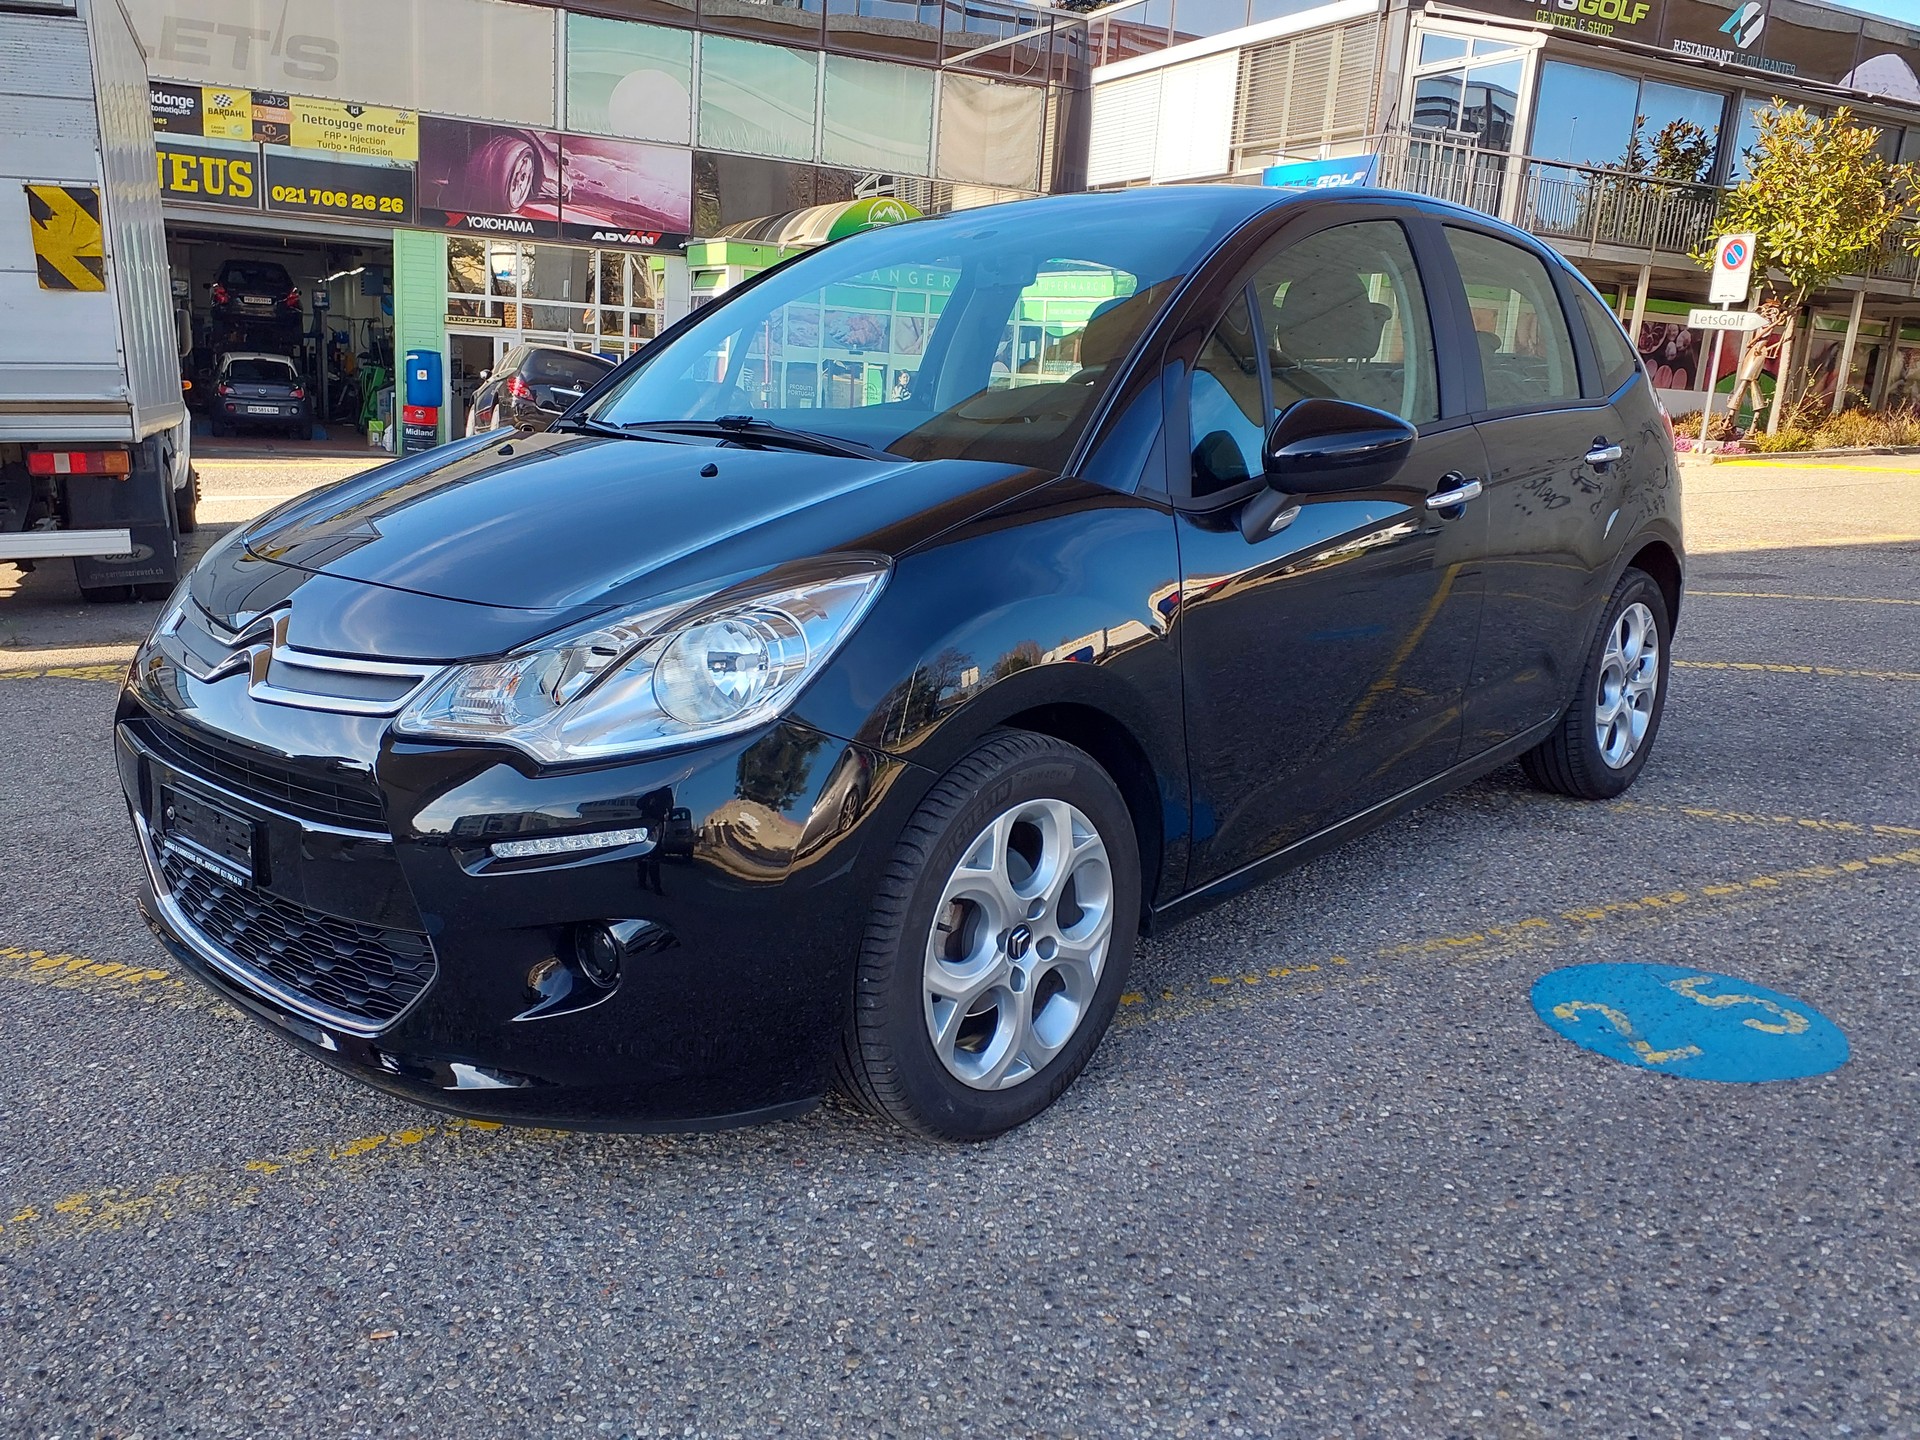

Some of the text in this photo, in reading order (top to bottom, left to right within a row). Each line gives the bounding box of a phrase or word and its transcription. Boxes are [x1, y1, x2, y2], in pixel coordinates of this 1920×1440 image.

[1535, 9, 1614, 37] CENTER & SHOP
[144, 0, 340, 82] ET'S
[1673, 39, 1735, 63] RESTAURANT
[150, 90, 195, 109] idange
[208, 107, 247, 120] BARDAHL
[302, 113, 363, 131] Nettoyage
[366, 125, 406, 136] moteur
[317, 140, 393, 156] Turbo Admission
[324, 131, 386, 146] FAP Injection
[272, 185, 404, 214] 021 706 26 26
[466, 215, 535, 234] YOKOHAMA
[591, 231, 655, 245] ADVAN
[1694, 313, 1745, 326] LetsGolf
[405, 427, 435, 437] Midland
